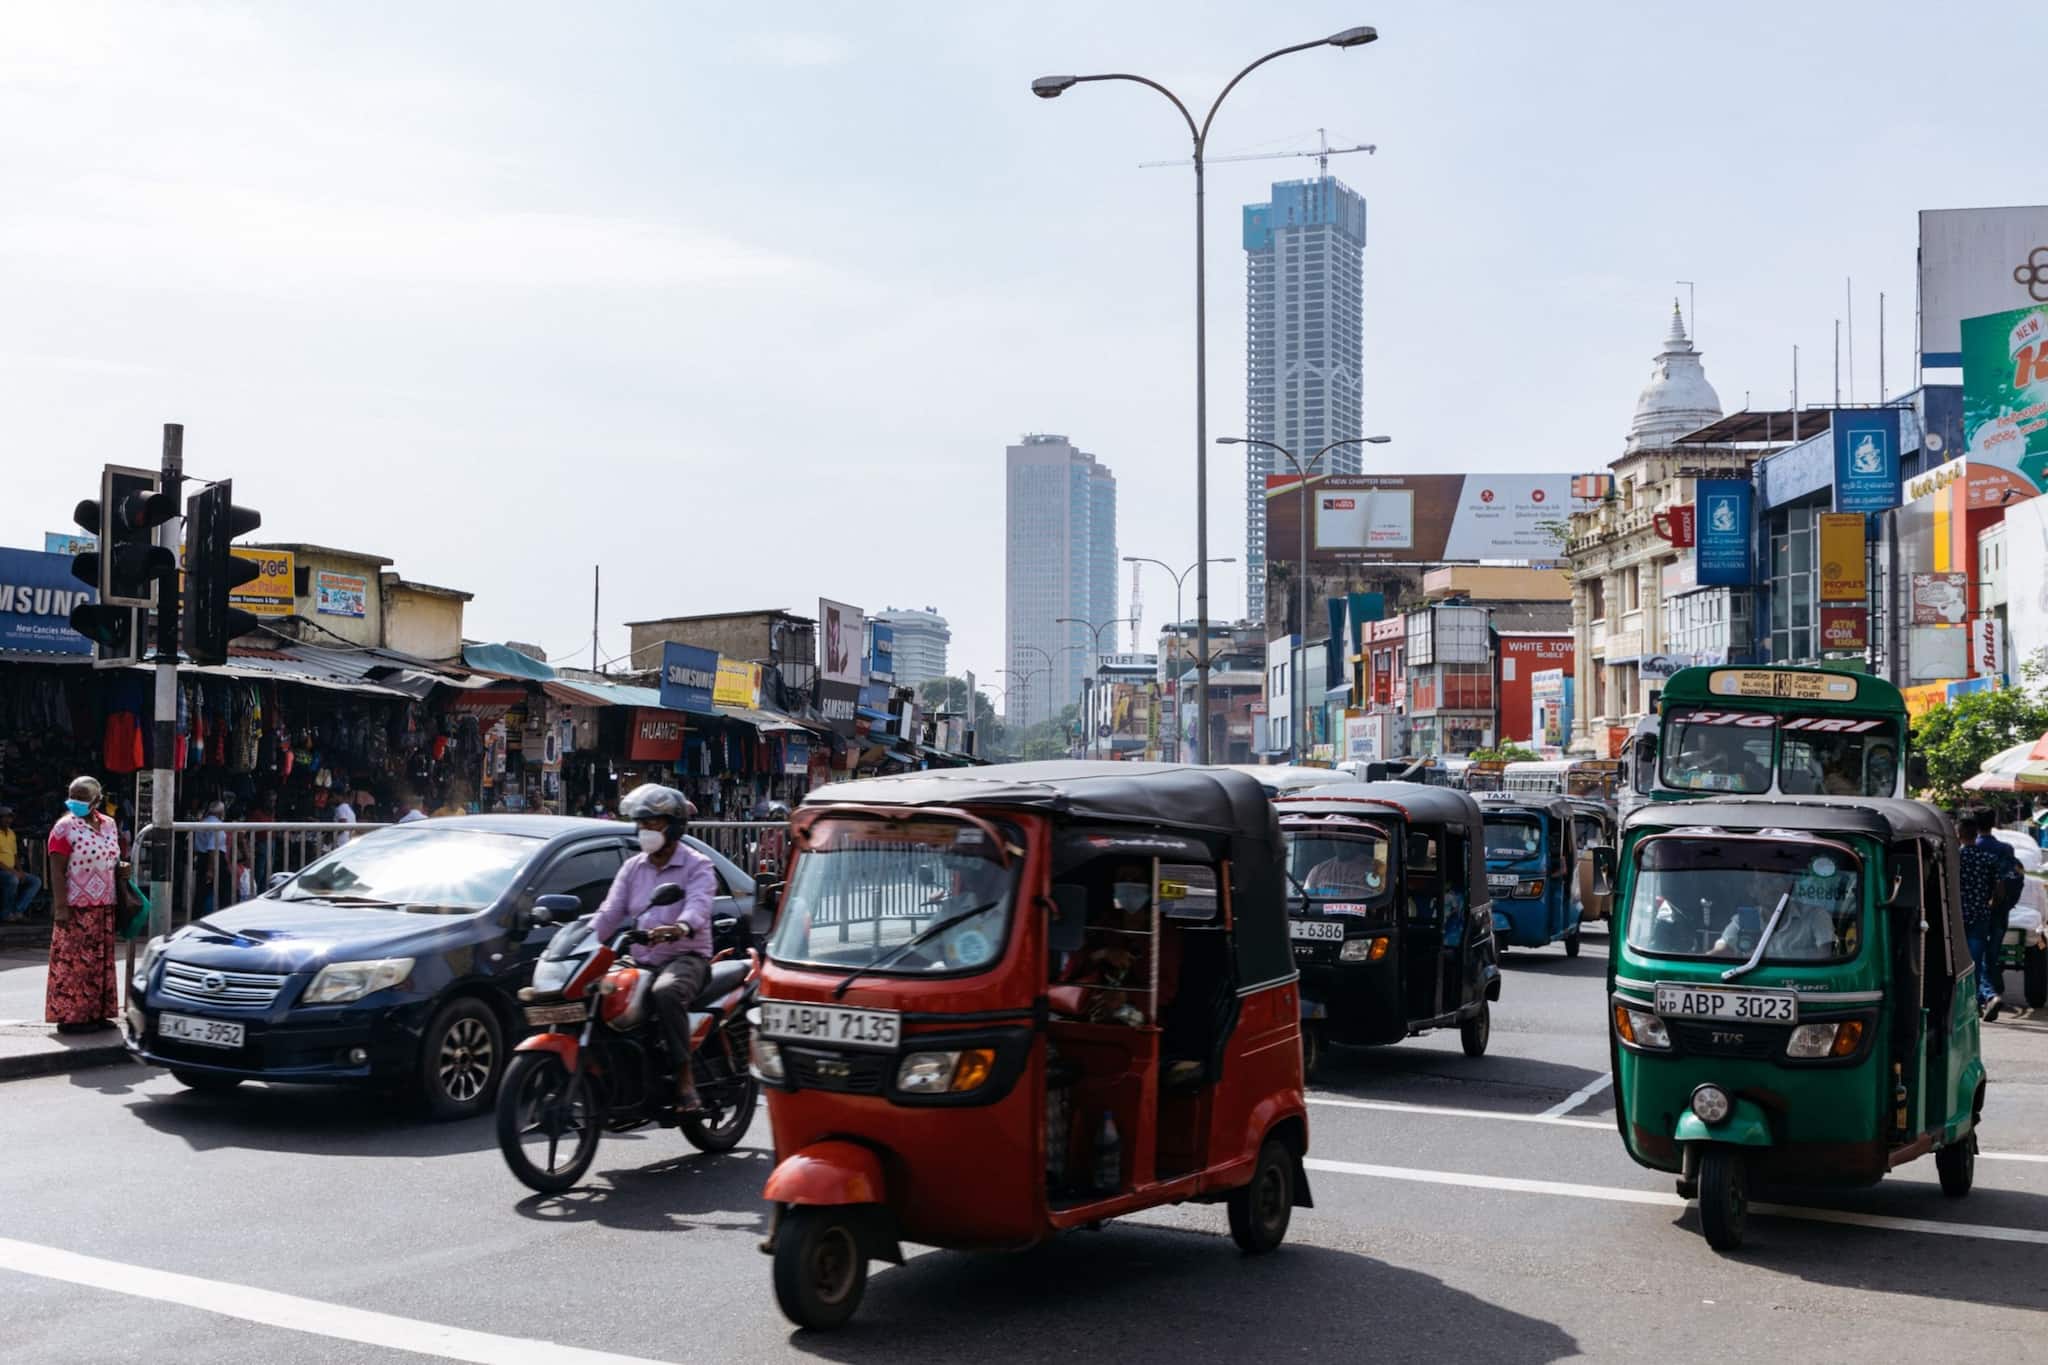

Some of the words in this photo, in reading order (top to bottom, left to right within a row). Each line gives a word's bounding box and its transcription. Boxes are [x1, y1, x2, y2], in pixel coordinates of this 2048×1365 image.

[2016, 319, 2039, 340] NEW
[1832, 620, 1856, 629] ATM
[1825, 629, 1852, 639] CDM
[1509, 642, 1544, 651] WHITE
[1983, 621, 1996, 669] Bata
[1099, 655, 1113, 664] TO
[1115, 655, 1134, 664] LET
[1774, 673, 1792, 696] 138
[822, 698, 854, 720] SAMSUNG
[1308, 924, 1342, 938] 6386
[1682, 994, 1725, 1014] ABP
[1735, 996, 1791, 1019] 3023
[785, 1008, 830, 1036] ABH
[838, 1013, 897, 1042] 7135
[1712, 1031, 1744, 1043] TVS
